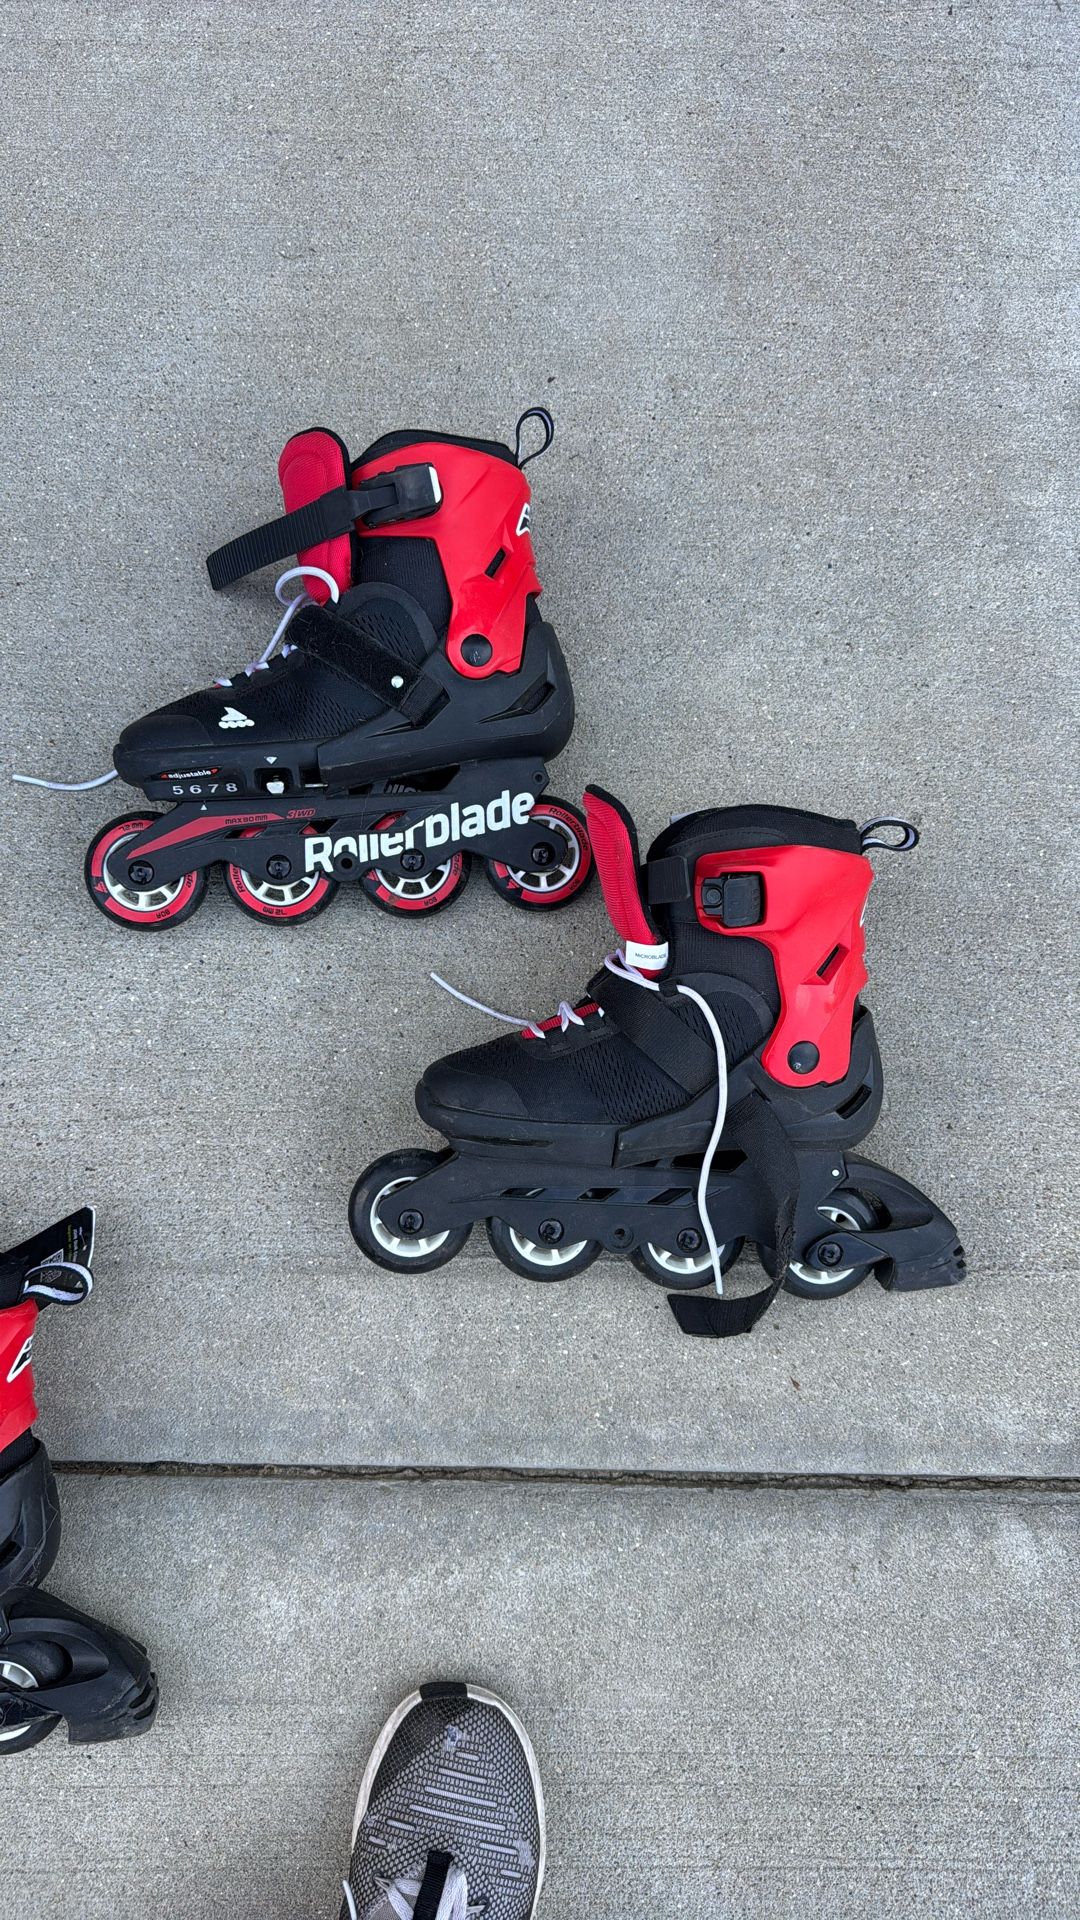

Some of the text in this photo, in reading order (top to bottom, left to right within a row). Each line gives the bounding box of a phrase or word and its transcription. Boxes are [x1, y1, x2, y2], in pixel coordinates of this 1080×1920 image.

[167, 770, 212, 780] adjustable
[172, 782, 238, 795] 5 6 7 8
[224, 817, 242, 825] MAX
[304, 789, 535, 873] Rollerblade
[548, 807, 589, 851] Rollerblade
